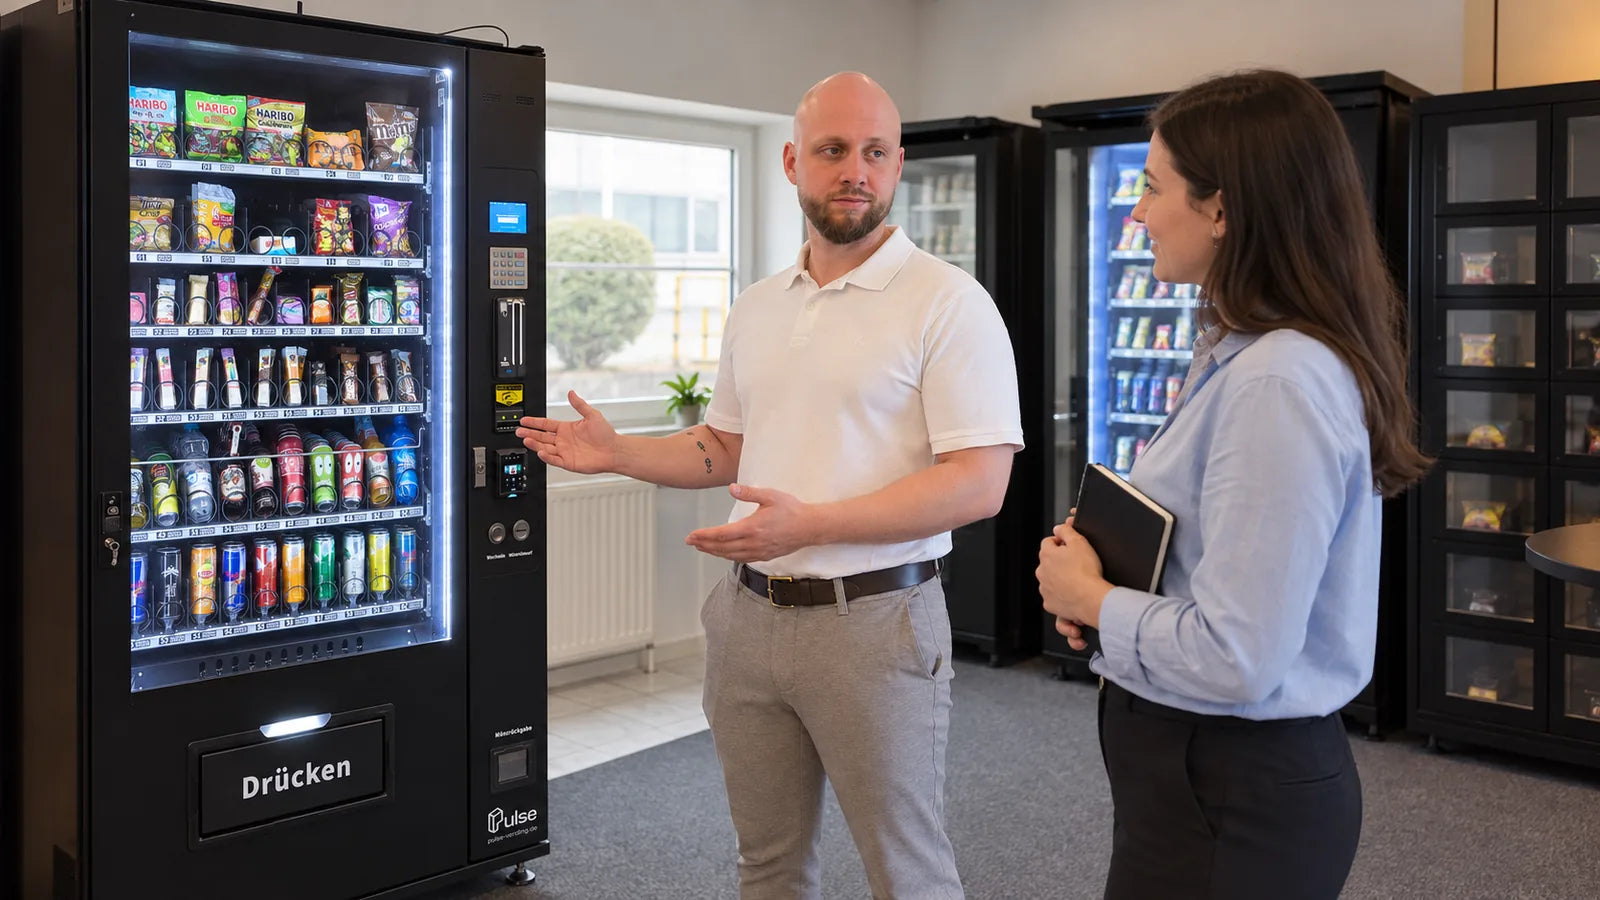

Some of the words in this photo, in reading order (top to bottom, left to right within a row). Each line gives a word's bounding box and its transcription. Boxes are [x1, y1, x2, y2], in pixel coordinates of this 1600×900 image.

[196, 101, 238, 116] HARIBO
[256, 108, 294, 122] HARIBO
[242, 759, 351, 800] Drücken
[487, 807, 538, 834] Pulse
